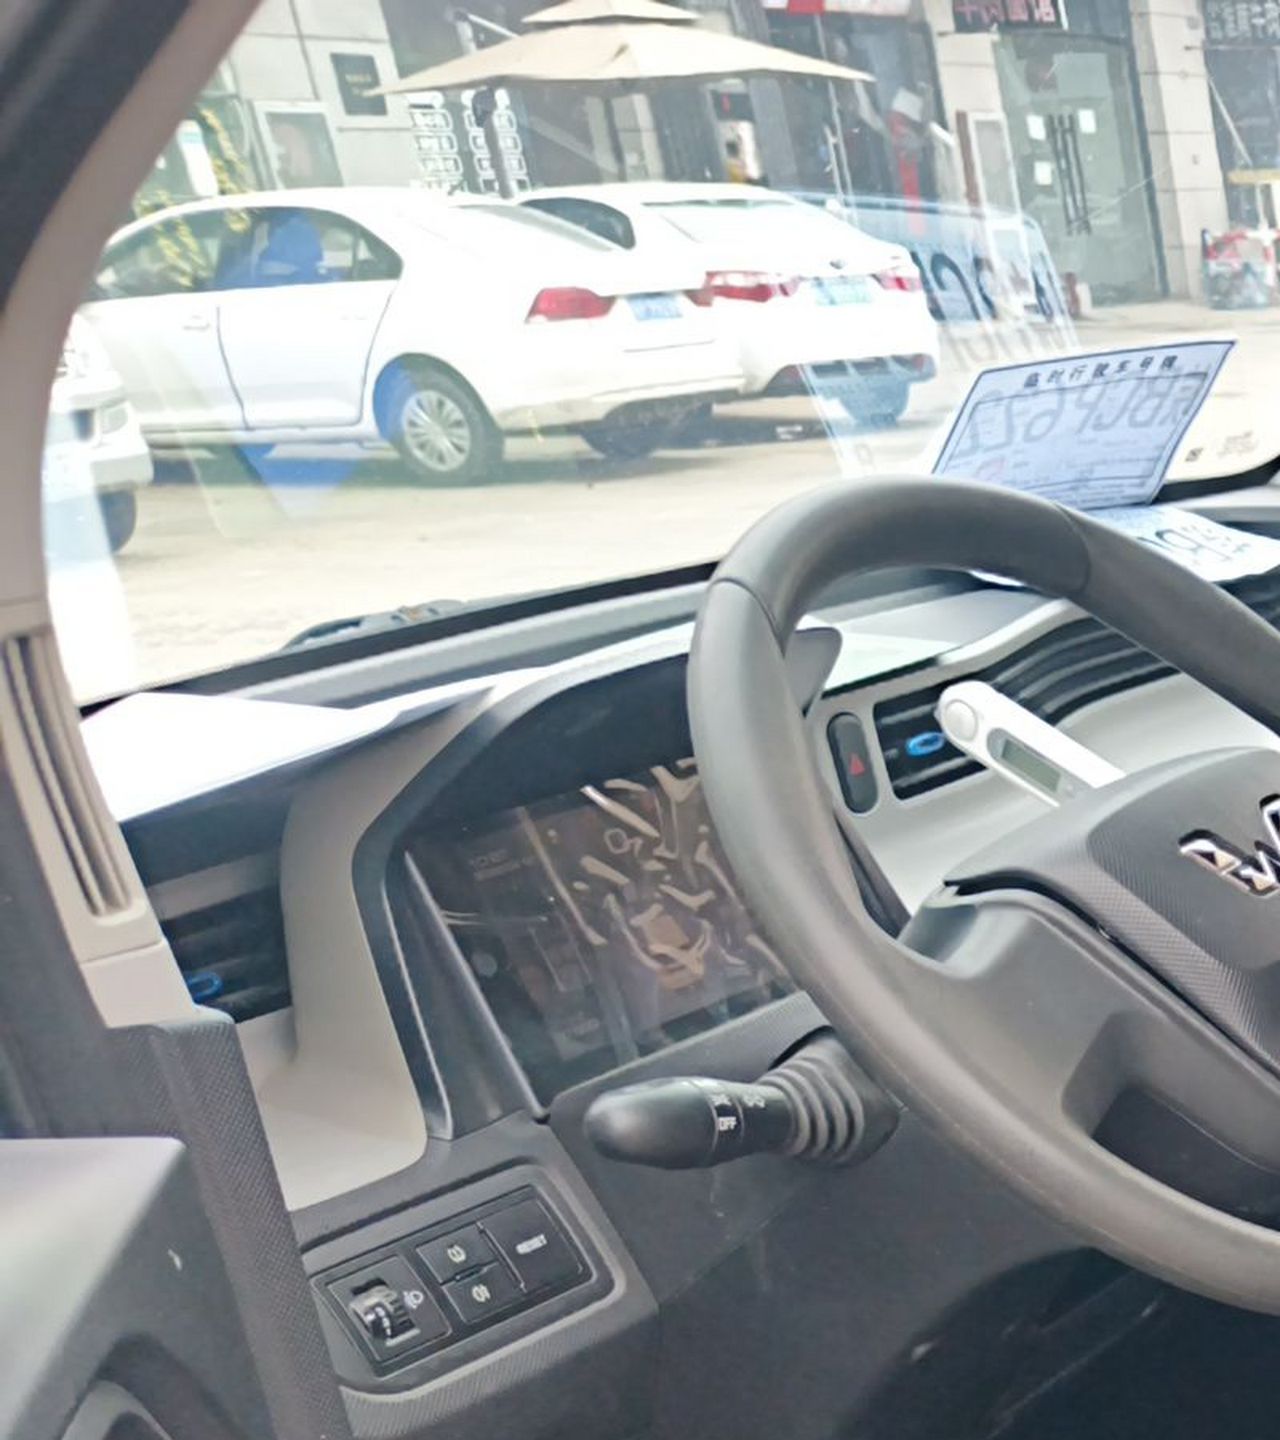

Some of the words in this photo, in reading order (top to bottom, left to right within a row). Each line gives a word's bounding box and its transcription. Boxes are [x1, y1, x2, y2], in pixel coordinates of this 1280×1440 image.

[1023, 354, 1179, 388] 临时行驶车号牌
[718, 1116, 738, 1131] OFF
